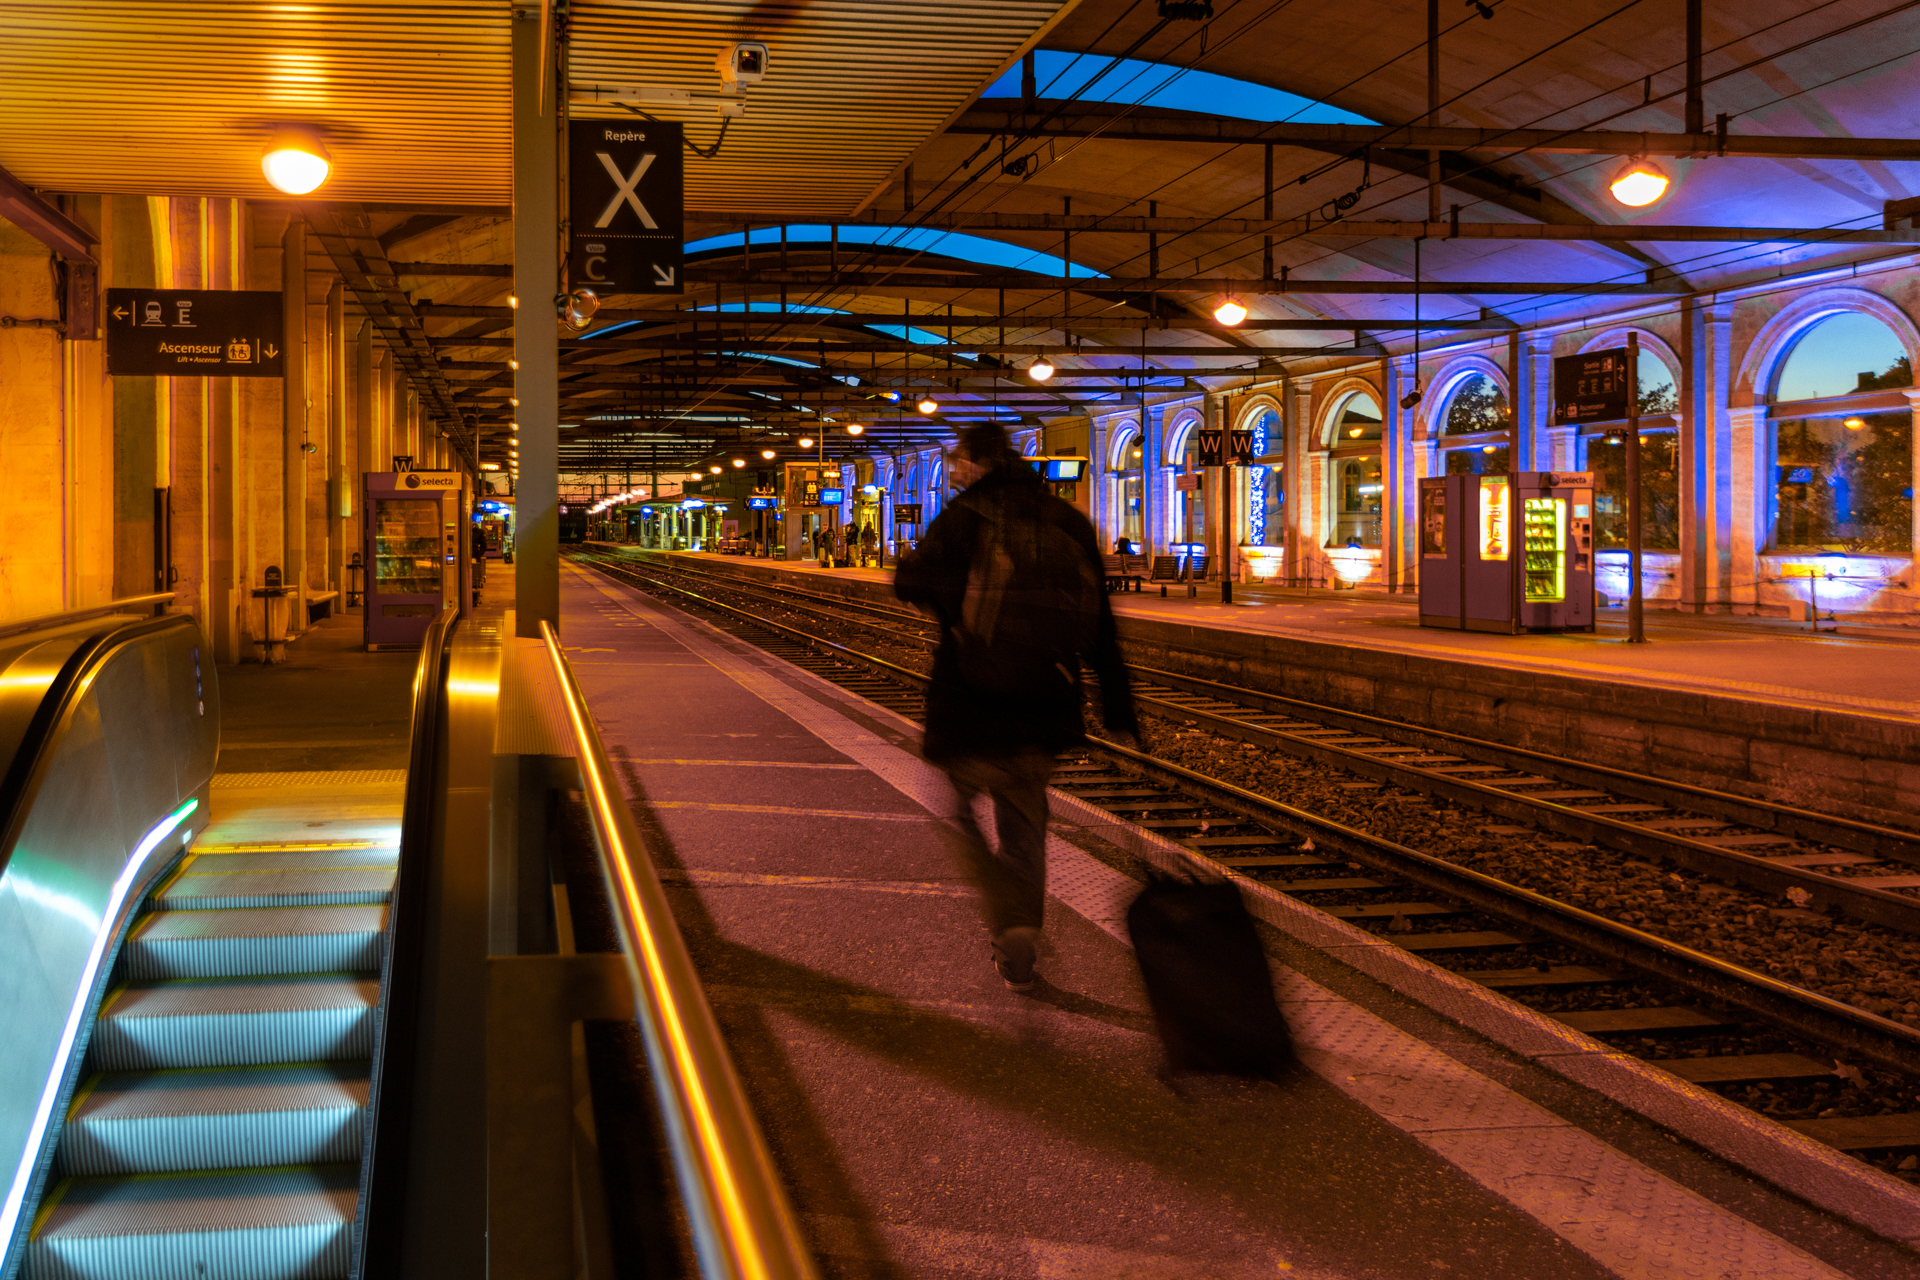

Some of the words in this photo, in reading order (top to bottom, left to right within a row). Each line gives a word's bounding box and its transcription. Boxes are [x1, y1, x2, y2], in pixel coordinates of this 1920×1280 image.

[605, 130, 646, 143] Repère
[594, 153, 659, 229] X
[585, 256, 607, 281] C
[179, 308, 191, 324] E
[159, 342, 222, 354] Ascenseur
[1200, 436, 1221, 453] W
[1232, 436, 1253, 453] W
[394, 460, 412, 472] W
[422, 478, 454, 486] selecta
[1561, 476, 1587, 484] selecta
